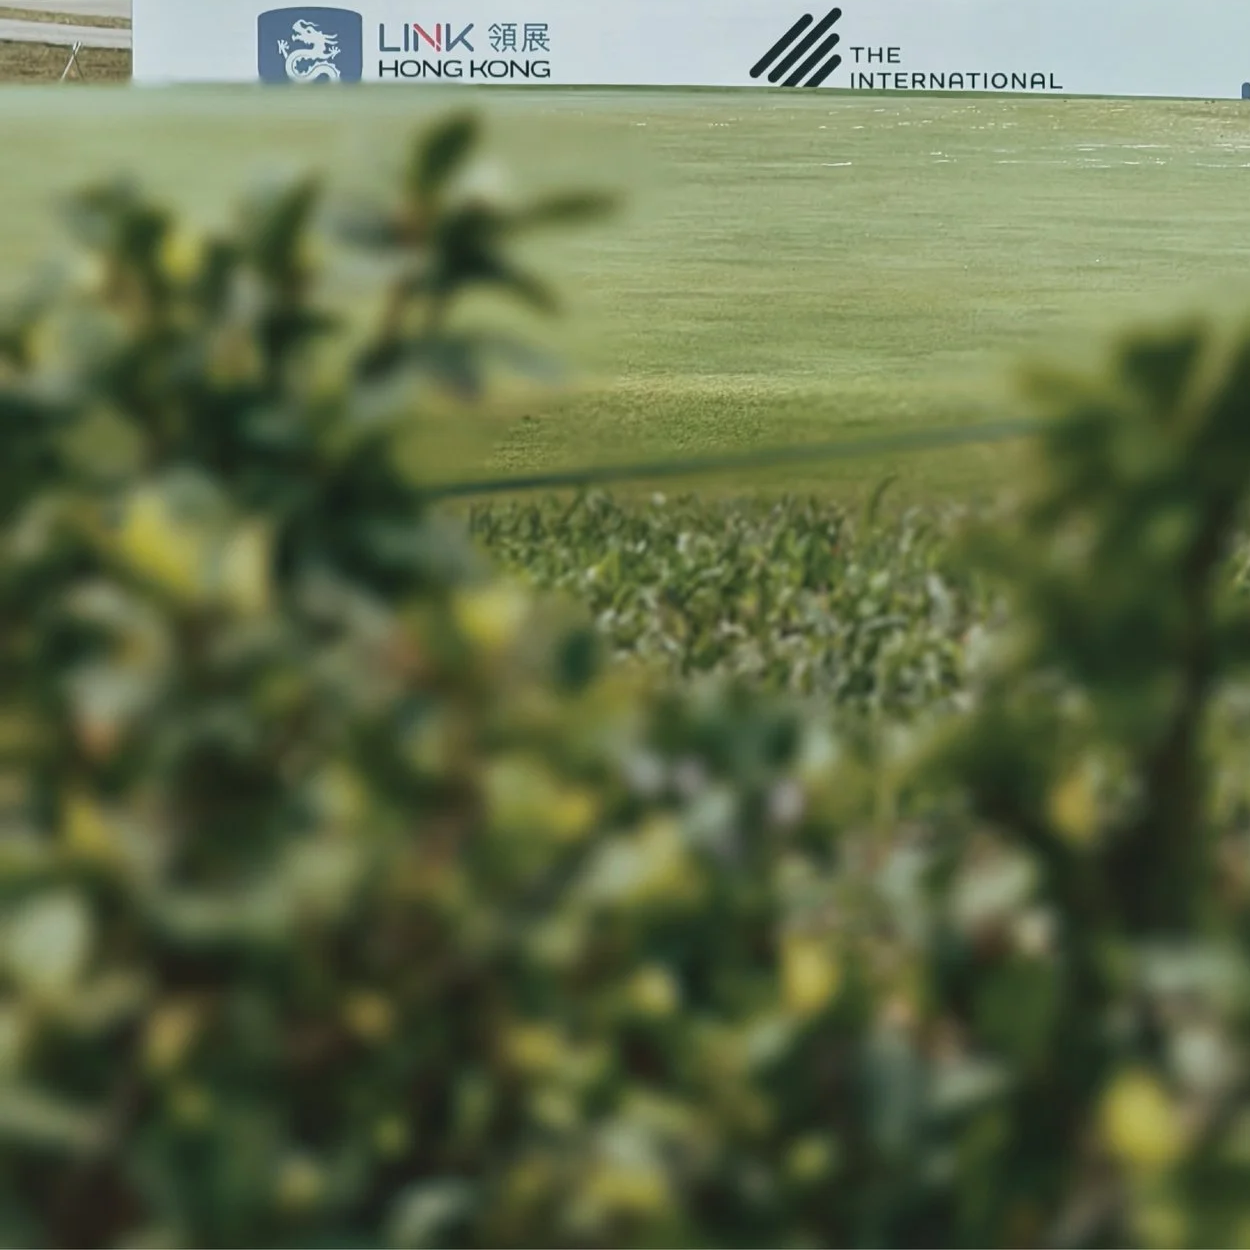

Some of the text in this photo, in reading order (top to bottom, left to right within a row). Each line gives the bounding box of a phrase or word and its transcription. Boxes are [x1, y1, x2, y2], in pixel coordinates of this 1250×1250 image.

[379, 23, 475, 52] LINK
[488, 23, 551, 53] 領展
[850, 46, 901, 64] THE
[378, 59, 551, 78] HONG KONG
[850, 72, 1063, 89] INTERNATIONAL
